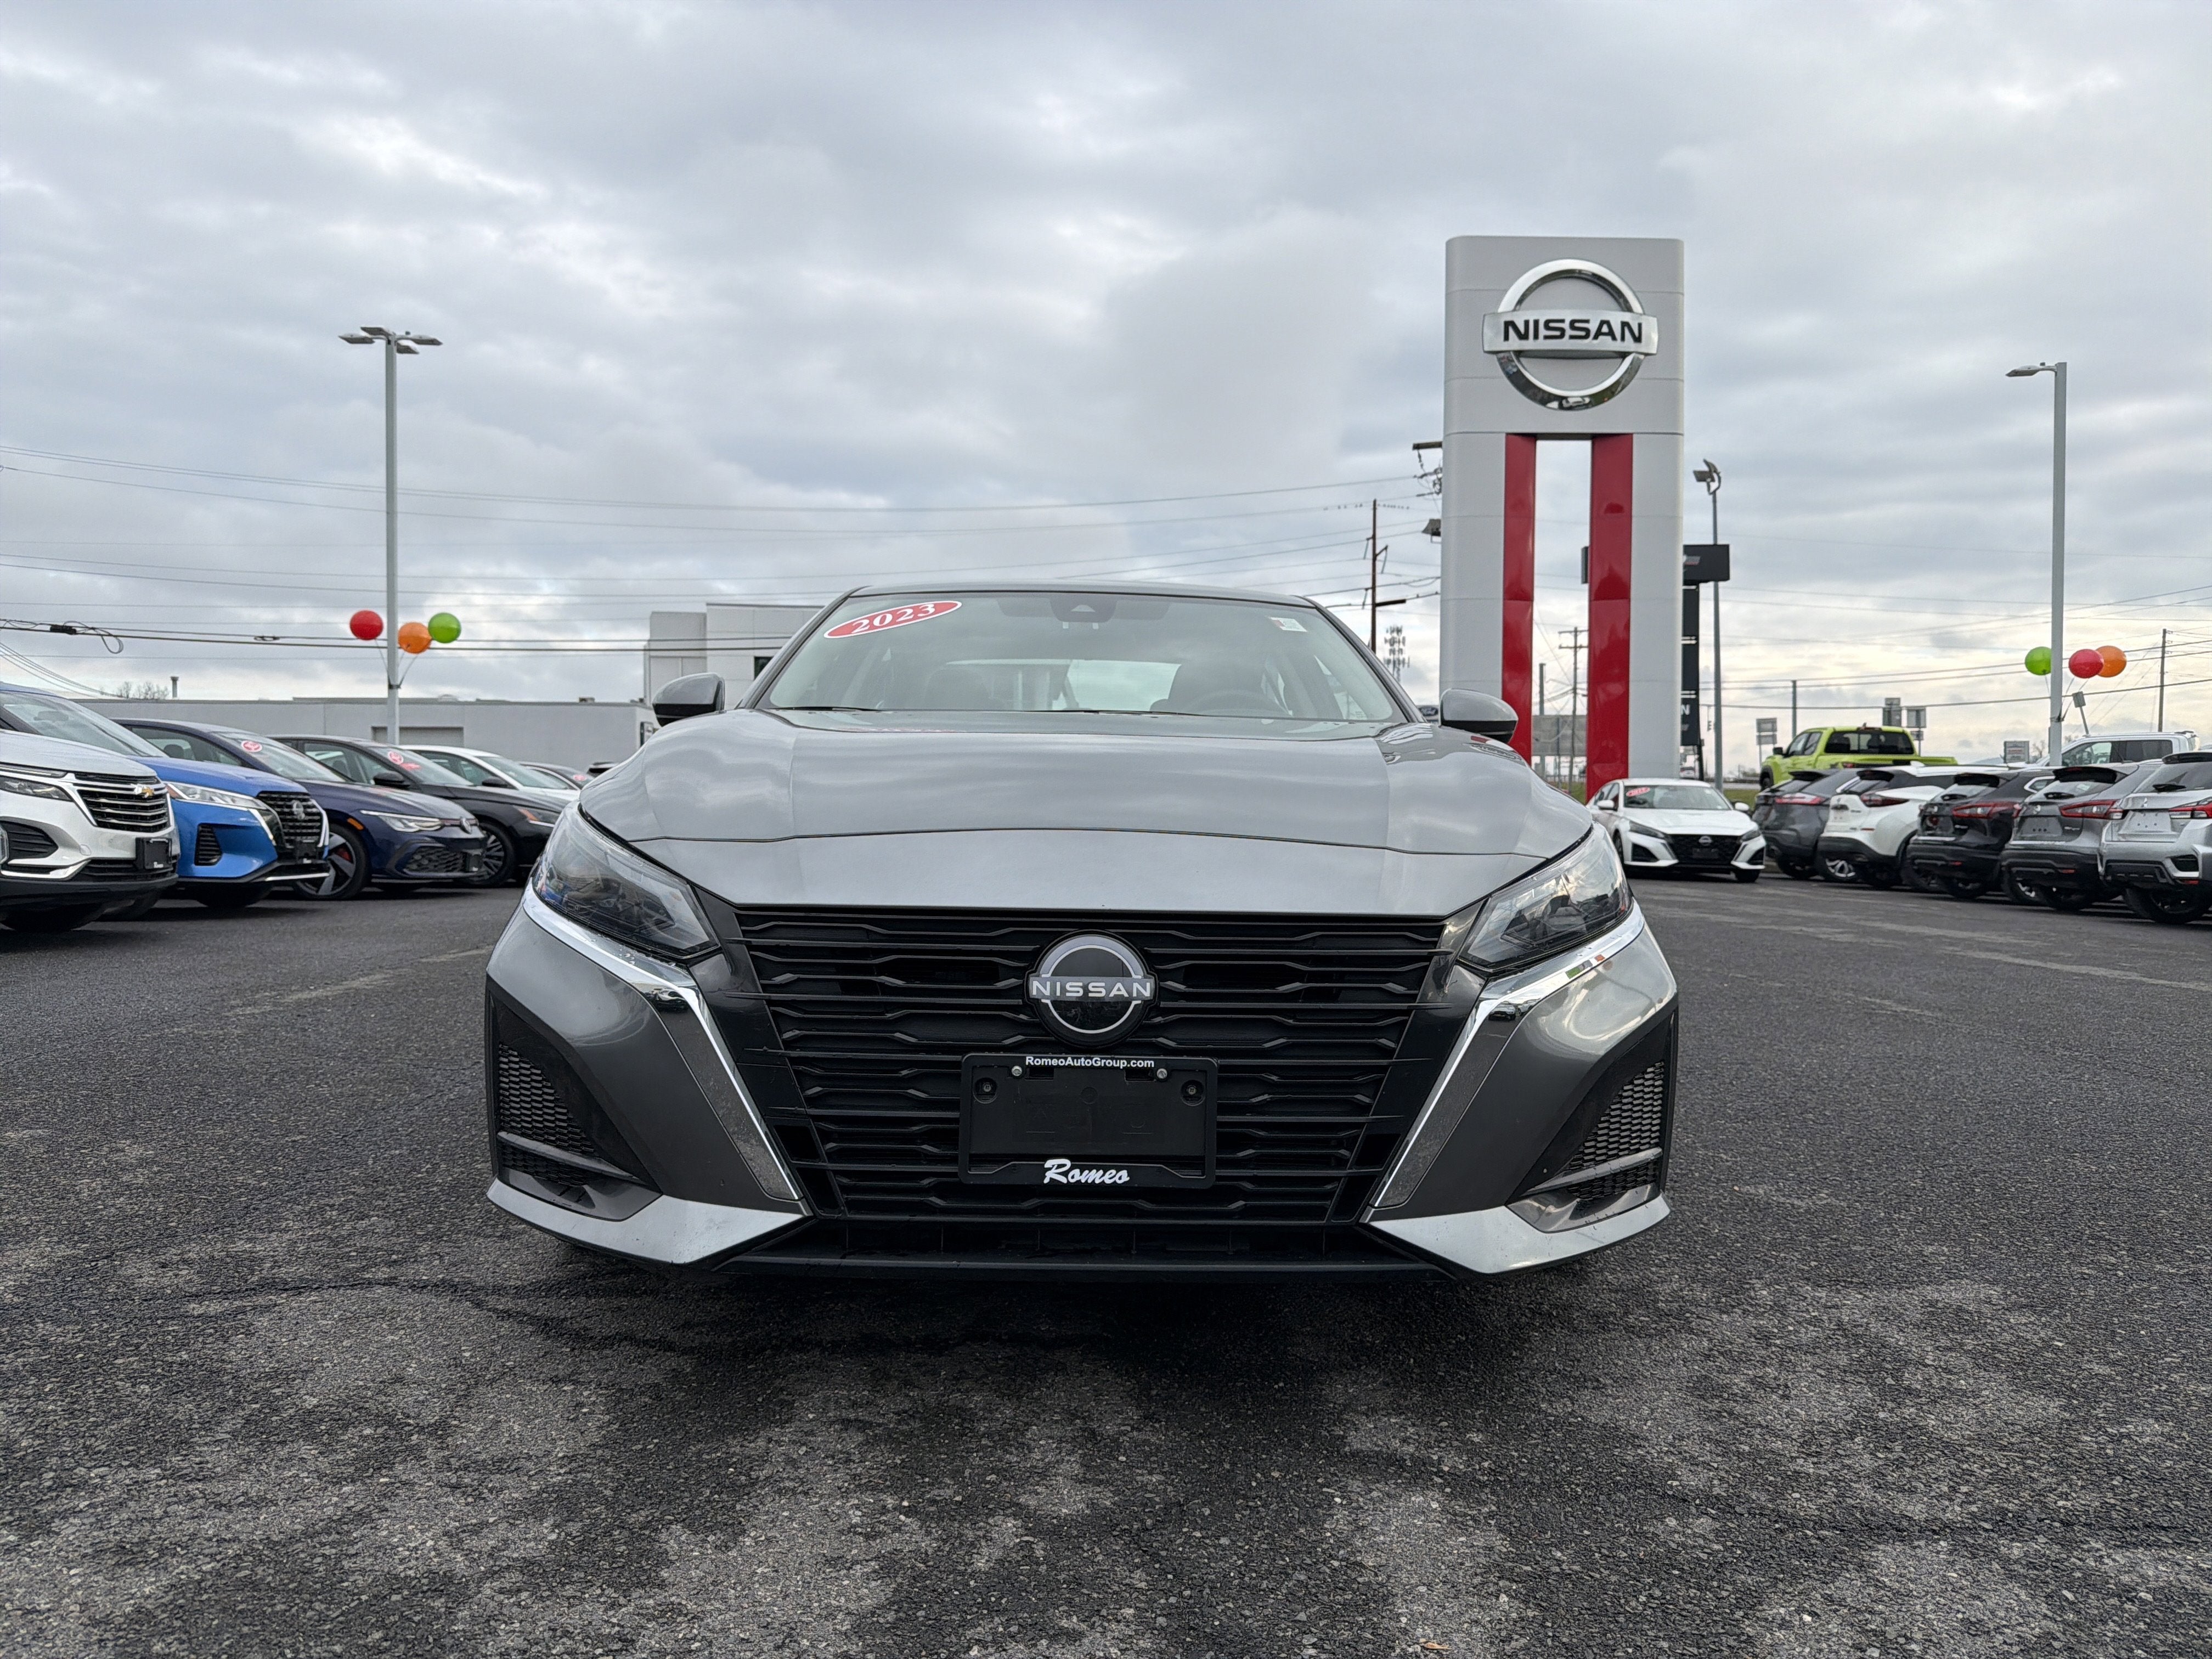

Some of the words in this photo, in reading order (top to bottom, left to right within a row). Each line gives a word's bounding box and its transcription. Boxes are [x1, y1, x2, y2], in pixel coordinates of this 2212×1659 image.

[1503, 318, 1643, 343] NISSAN
[851, 603, 935, 634] 2023
[1032, 980, 1150, 997] NISSAN
[1025, 1056, 1155, 1069] RomeoAutoGroup.com
[1043, 1158, 1130, 1184] Romeo
